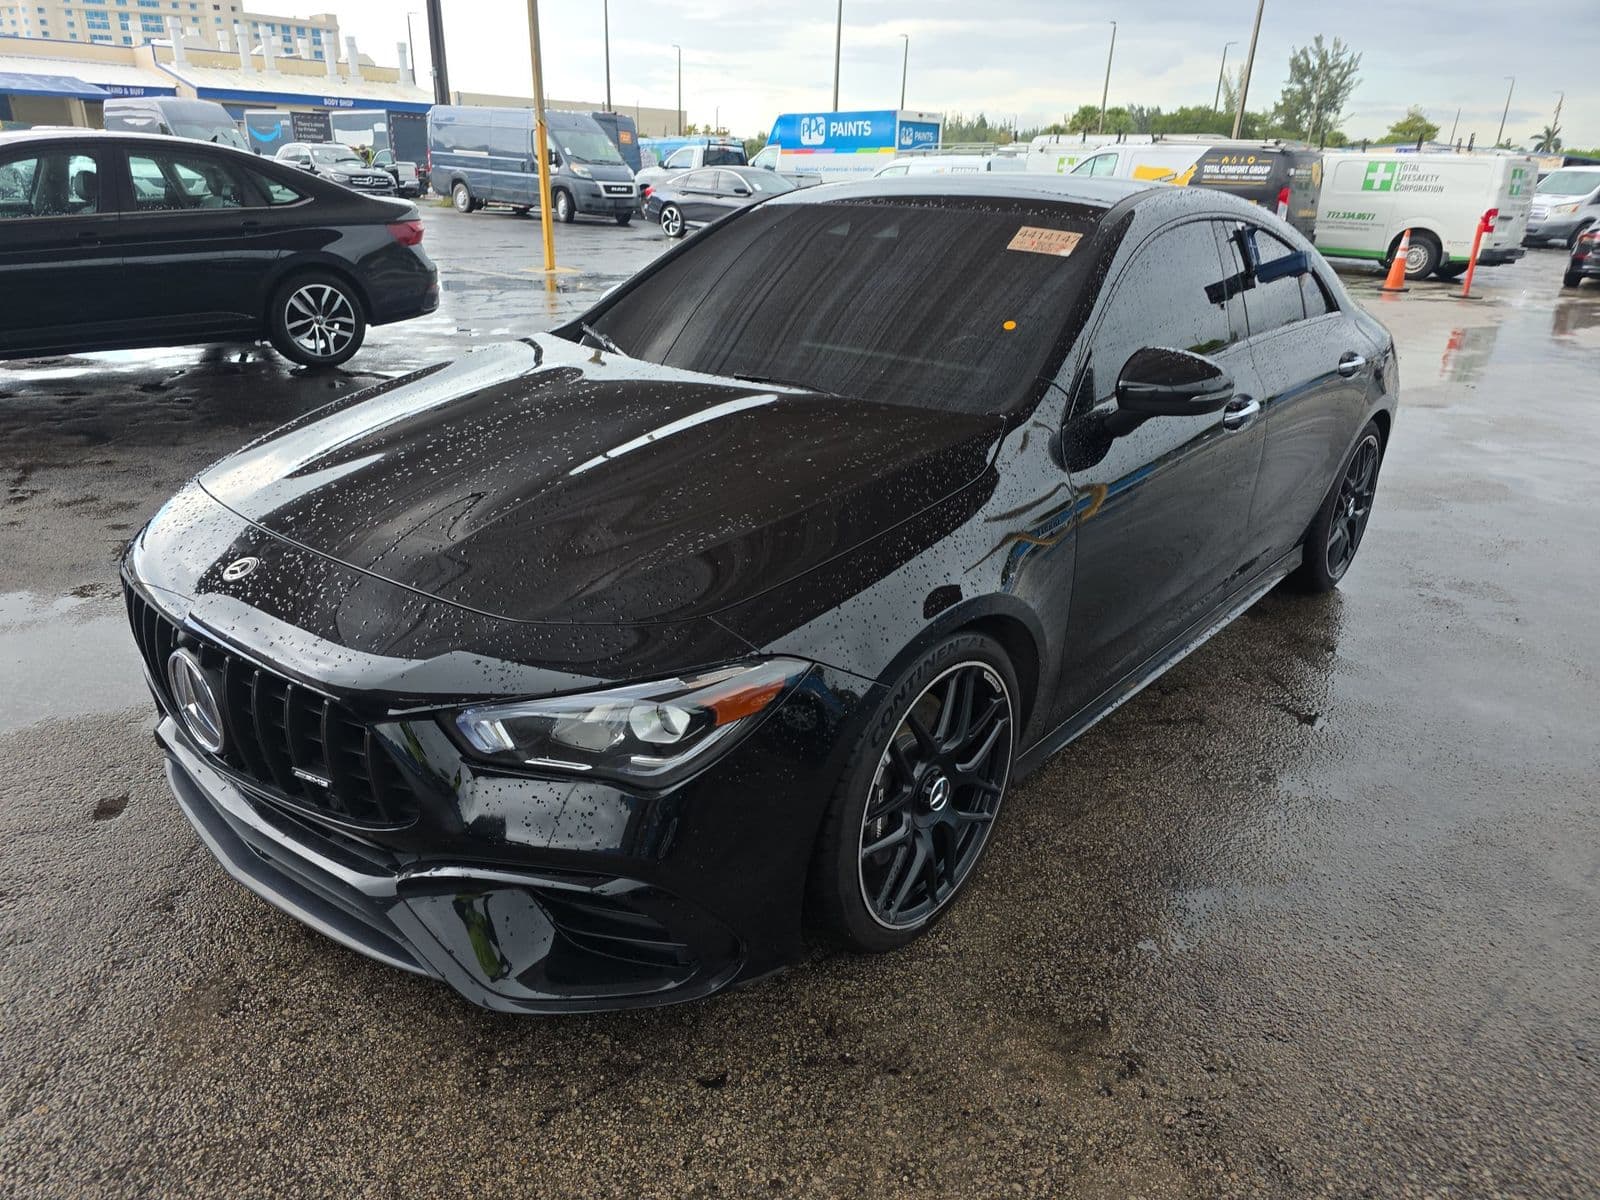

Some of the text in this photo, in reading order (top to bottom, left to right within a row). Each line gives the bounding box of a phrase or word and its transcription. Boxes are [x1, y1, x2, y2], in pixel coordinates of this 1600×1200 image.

[323, 98, 354, 107] BODY SHOP
[801, 117, 872, 145] PPG PAINTS
[914, 131, 933, 141] PAINTS
[1203, 164, 1271, 174] TOTAL COMFORT GROUP
